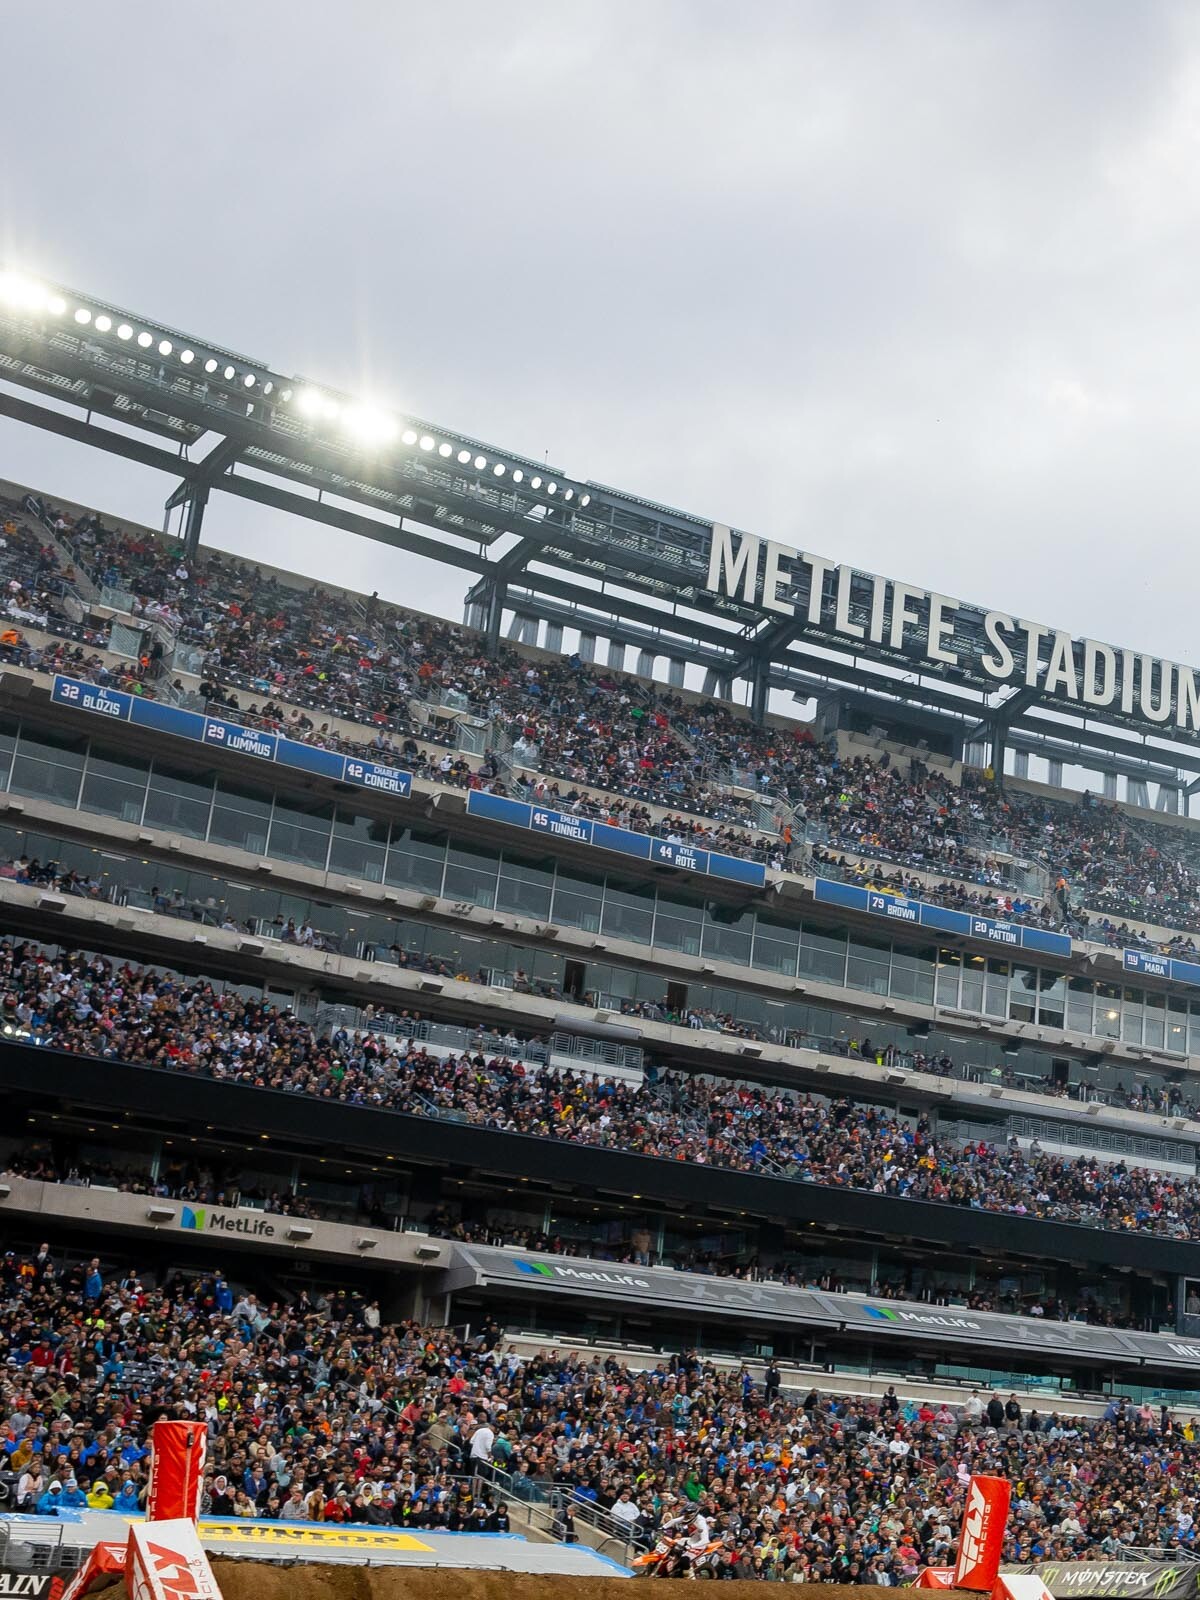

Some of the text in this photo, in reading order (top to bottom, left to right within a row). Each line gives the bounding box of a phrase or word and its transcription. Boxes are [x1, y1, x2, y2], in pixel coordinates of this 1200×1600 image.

[705, 522, 960, 665] METLIFE
[60, 683, 80, 699] 32
[98, 689, 108, 699] AL
[82, 694, 121, 715] BLOZIS
[207, 724, 225, 740] 29
[241, 729, 260, 741] JACK
[226, 734, 271, 757] LUMMUS
[347, 763, 363, 778] 42
[373, 766, 400, 779] CHARLIE
[364, 773, 406, 793] CONERLY
[534, 812, 548, 826] 45
[550, 820, 588, 841] TUNNELL
[659, 845, 672, 858] 44
[679, 847, 694, 857] KYLE
[675, 854, 697, 870] ROTE
[872, 896, 885, 909] 79
[887, 904, 916, 920] BROWN
[975, 921, 987, 933] 20
[988, 928, 1017, 943] PATTON
[1144, 961, 1165, 975] MARA
[210, 1213, 275, 1237] MetLife
[555, 1266, 649, 1288] MetLife
[900, 1311, 980, 1330] MetLife
[200, 1525, 400, 1544] DUNLOP
[976, 1504, 992, 1564] RACING
[1066, 1588, 1129, 1596] ENERGY
